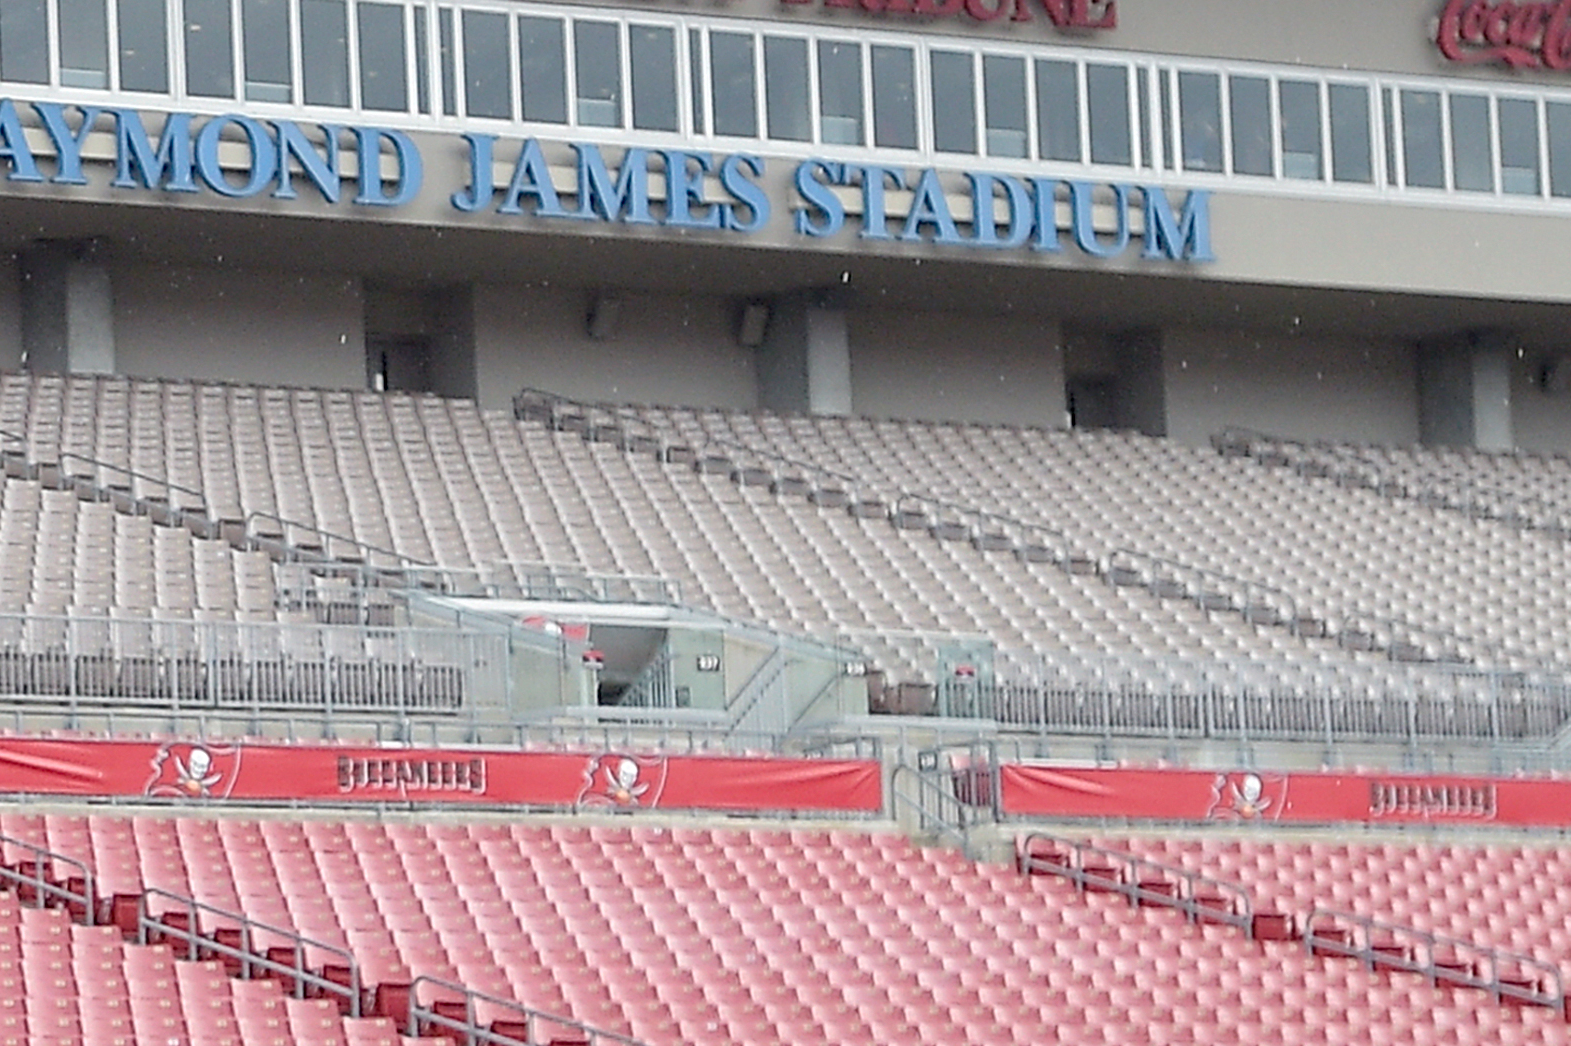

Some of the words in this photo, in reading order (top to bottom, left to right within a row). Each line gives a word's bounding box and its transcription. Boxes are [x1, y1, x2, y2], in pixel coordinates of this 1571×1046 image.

[450, 132, 771, 232] JAMES
[794, 157, 1217, 263] STADIUM
[337, 755, 486, 798] BUCCANEERS
